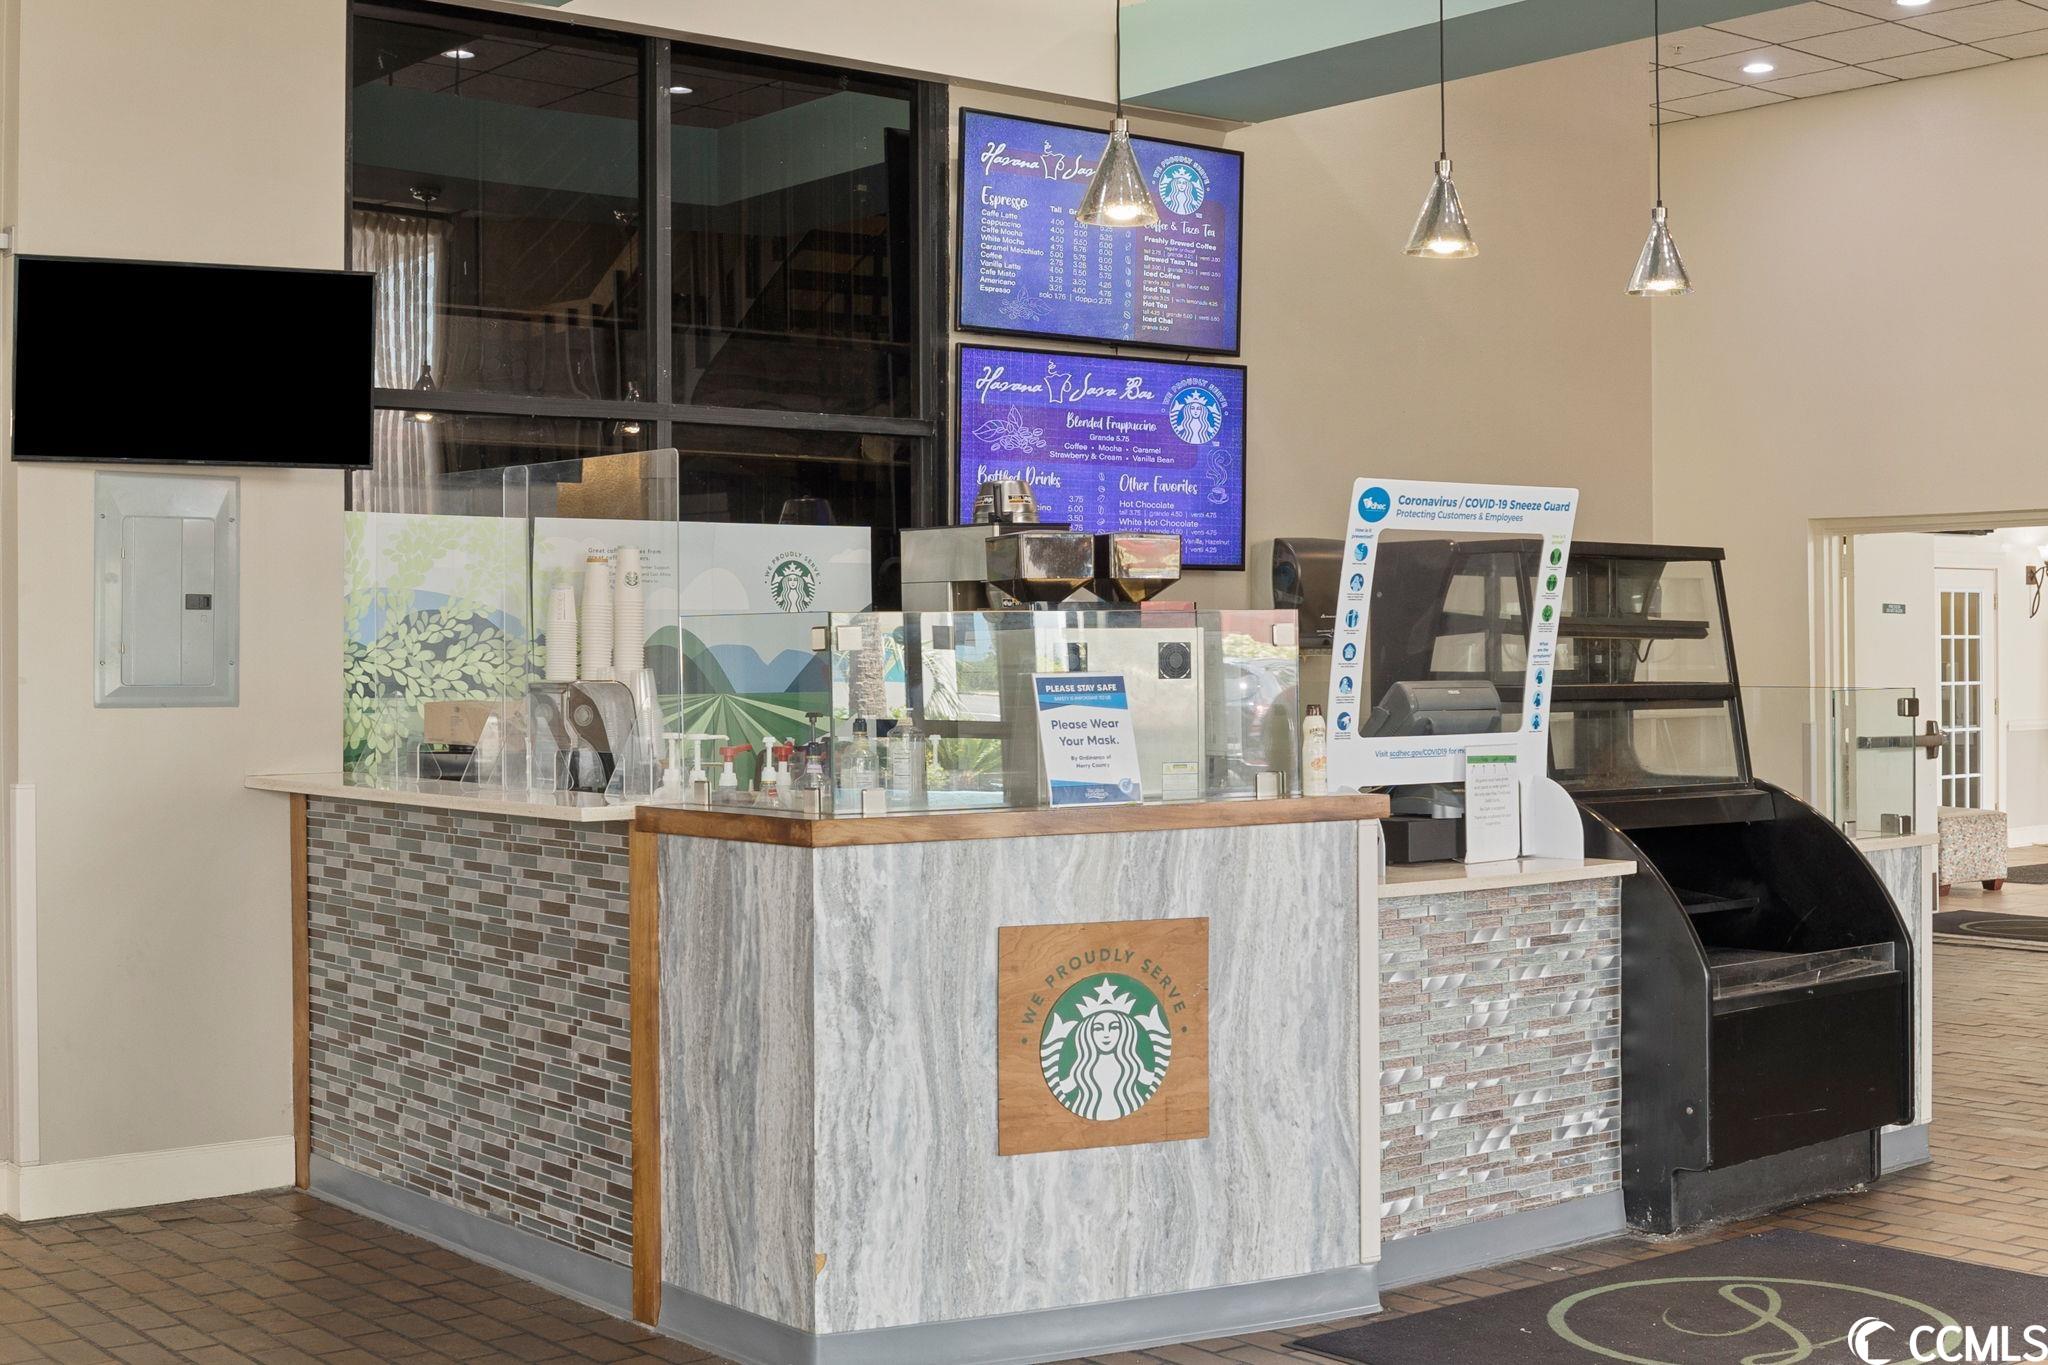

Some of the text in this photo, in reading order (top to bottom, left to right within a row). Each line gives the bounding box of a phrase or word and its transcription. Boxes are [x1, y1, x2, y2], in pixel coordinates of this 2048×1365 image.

[981, 142, 1096, 180] Havana Jav
[981, 185, 1029, 210] Espresso
[981, 208, 999, 218] Caffe
[1001, 210, 1018, 219] Latte
[1050, 205, 1062, 214] Tall
[981, 218, 1021, 229] Cappuccino
[1050, 227, 1065, 235] 4.00
[981, 226, 999, 234] Caffe
[1000, 228, 1023, 237] Mocha
[1170, 221, 1178, 231] &
[1202, 223, 1216, 237] Tea
[980, 235, 1000, 243] White
[1002, 236, 1025, 246] Mocha
[1144, 236, 1217, 251] Freshly Brewed Coffee
[980, 243, 1009, 252] Caramel
[980, 251, 1113, 272] Coffee 2.75 3.25 3.50
[1144, 255, 1169, 264] Brewed
[980, 260, 1002, 268] Vanilla
[1004, 263, 1021, 271] Latte
[980, 268, 996, 276] Cafe
[997, 270, 1016, 278] Misto
[1049, 276, 1063, 284] 3.25
[1143, 270, 1181, 280] Iced Coffee
[980, 276, 1016, 286] Americano
[1049, 284, 1063, 292] 3.25
[1143, 285, 1158, 293] Iced
[980, 285, 1011, 295] Espresso
[1039, 291, 1053, 299] solo
[1075, 295, 1098, 304] doppio
[1156, 301, 1168, 309] Tea
[1158, 317, 1173, 325] Chai
[976, 366, 1155, 404] Havana Java Bar
[1066, 411, 1157, 433] Blended Frappuccino
[1089, 434, 1114, 442] Grande
[1064, 442, 1161, 454] Coffee Mocha Caramel
[1049, 450, 1089, 461] Strawberry
[1098, 453, 1122, 461] Cream
[1157, 456, 1175, 464] Bean
[1025, 466, 1061, 488] Drinks
[1119, 473, 1199, 496] Other Favorites
[1120, 500, 1175, 510] Hot Chocolate
[1398, 495, 1457, 508] Coronavirus
[1465, 498, 1508, 510] COVID-19
[1509, 500, 1542, 511] Sneeze
[1543, 501, 1571, 512] Guard
[1149, 511, 1170, 519] grande
[1396, 509, 1523, 523] Protecting Customers & Employees
[1119, 518, 1142, 526] White
[1159, 520, 1199, 528] Chocolate
[1076, 684, 1095, 692] STAY
[1097, 684, 1117, 692] SAFE
[1051, 719, 1119, 730] Please Wear
[1059, 735, 1120, 746] Your Mask.
[1375, 749, 1388, 758] Visit
[1022, 948, 1186, 1026] WE PROUDLY SERVE
